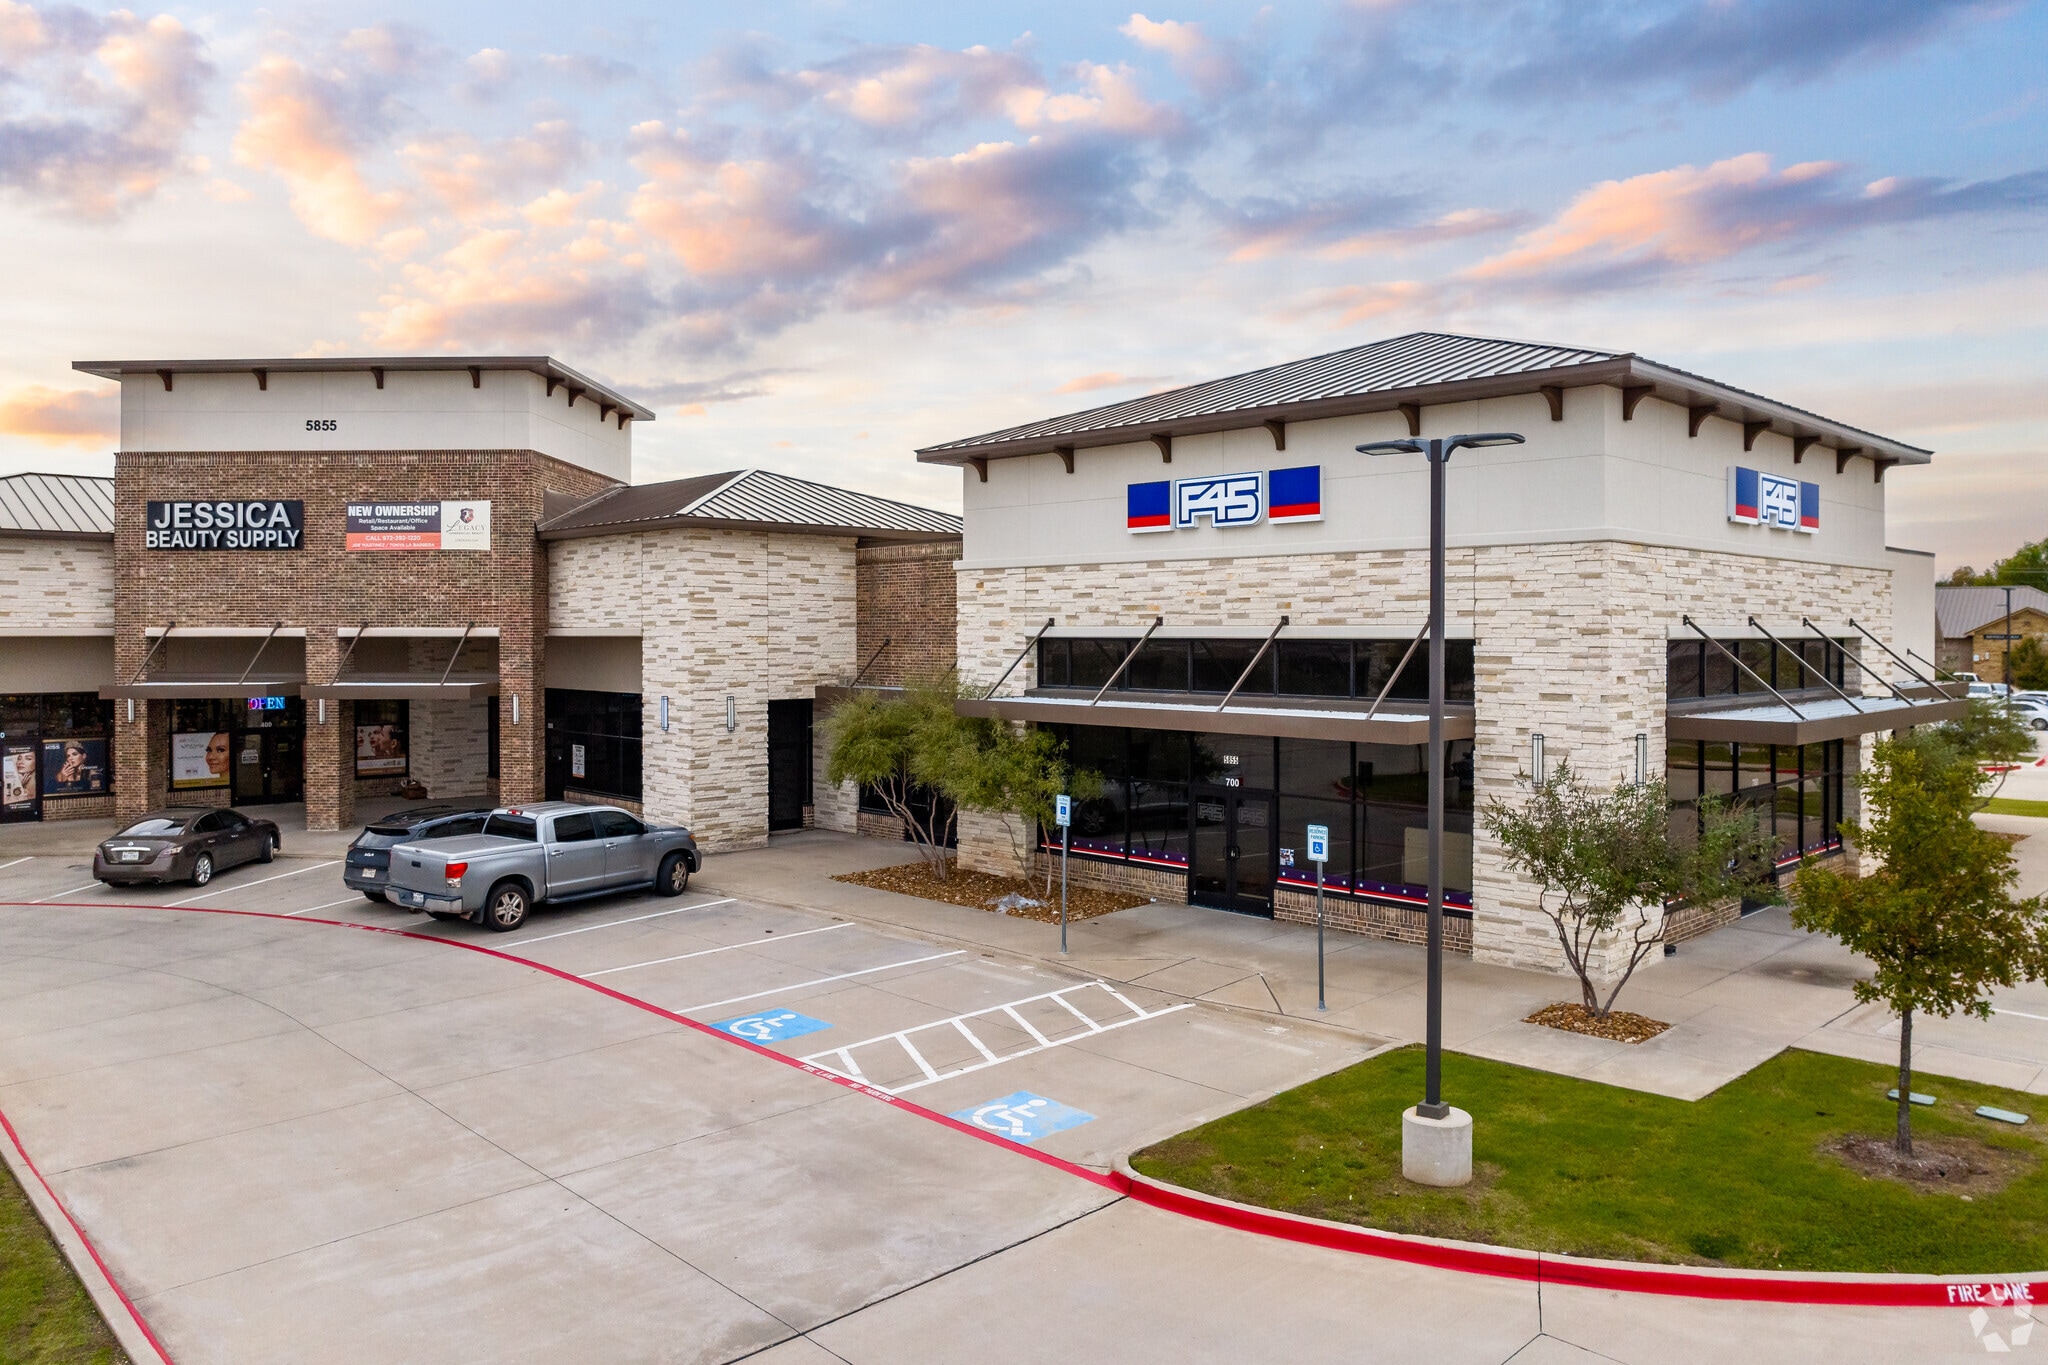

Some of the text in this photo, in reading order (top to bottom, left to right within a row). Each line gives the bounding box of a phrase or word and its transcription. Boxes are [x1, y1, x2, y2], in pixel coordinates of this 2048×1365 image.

[305, 420, 337, 431] 5855
[1178, 475, 1261, 526] F45
[1761, 477, 1797, 527] F45
[154, 502, 291, 529] JESSICA
[347, 505, 439, 516] NEW OWNERSHIP
[446, 520, 486, 533] LEGACY
[146, 529, 300, 548] BEAUTY SUPPLY
[248, 697, 285, 709] OPEN
[1225, 777, 1240, 787] 700
[799, 1064, 819, 1073] FIRE
[817, 1071, 839, 1080] LANE
[861, 1087, 895, 1102] PARKING
[1946, 1282, 2035, 1304] FIRE LANE
